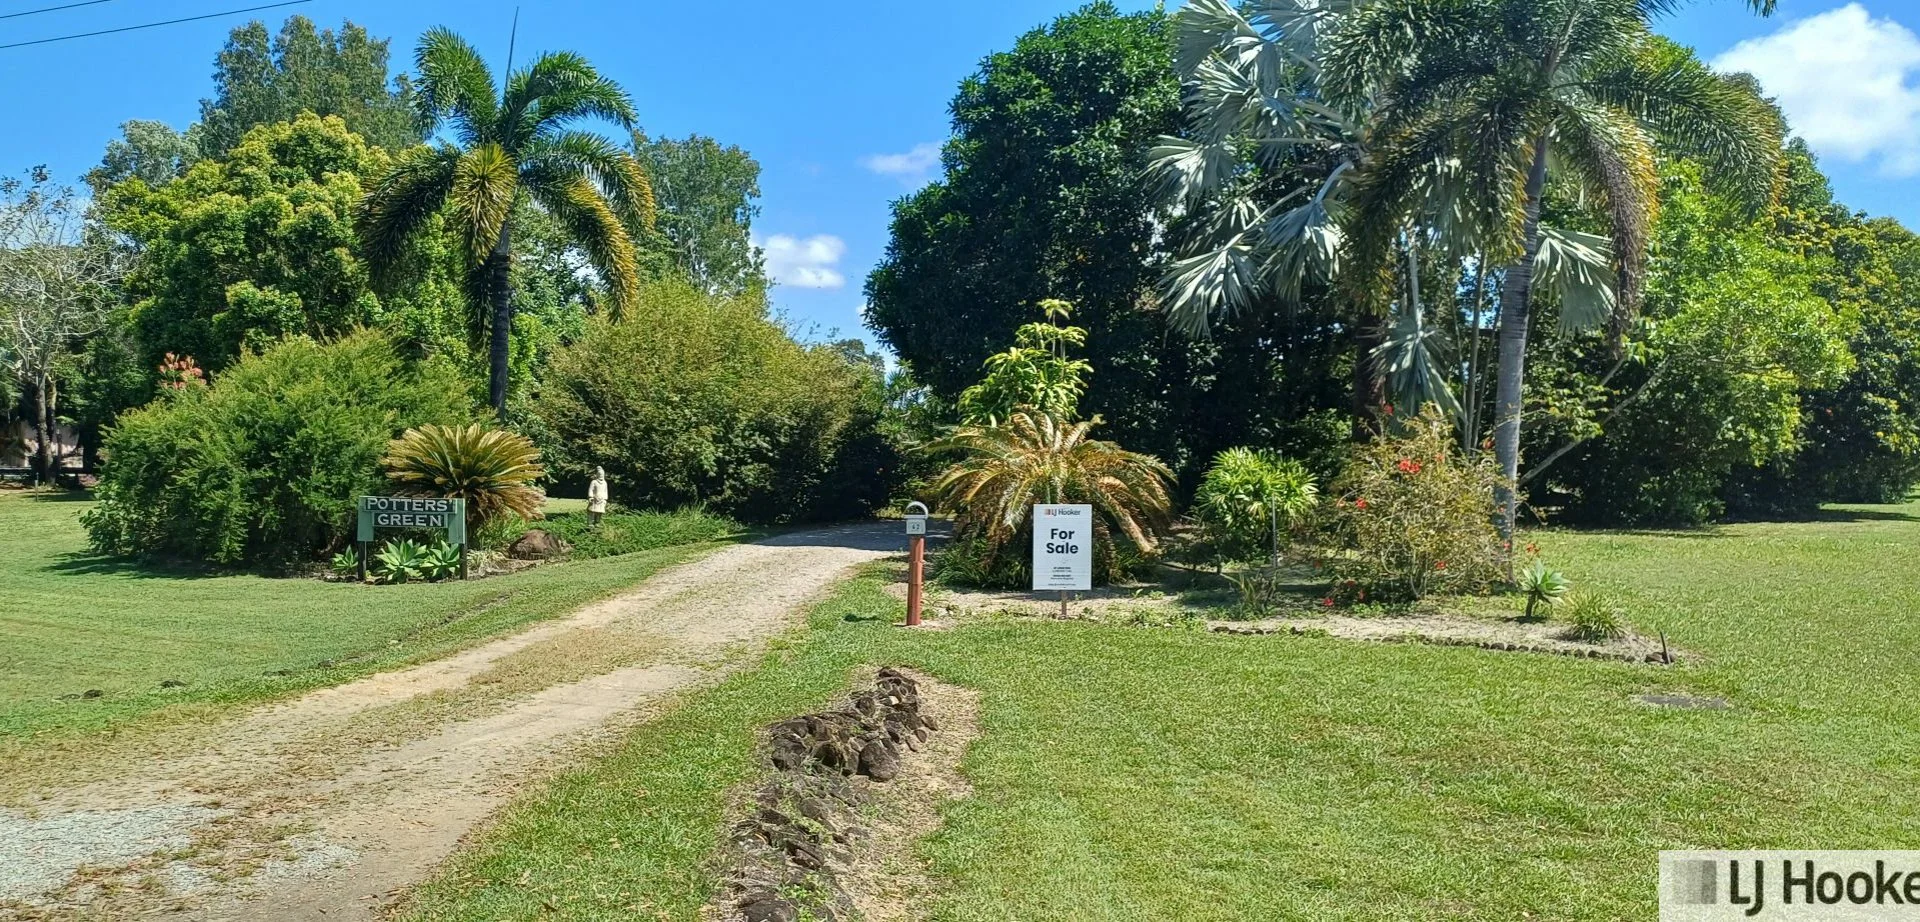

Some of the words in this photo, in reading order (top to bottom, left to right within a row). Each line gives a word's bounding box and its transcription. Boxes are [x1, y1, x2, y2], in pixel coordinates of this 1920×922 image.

[367, 498, 453, 512] POTTERS'
[1058, 508, 1081, 516] Hooker
[377, 513, 442, 527] GREEN
[1051, 528, 1075, 540] For
[1046, 542, 1079, 554] Sale
